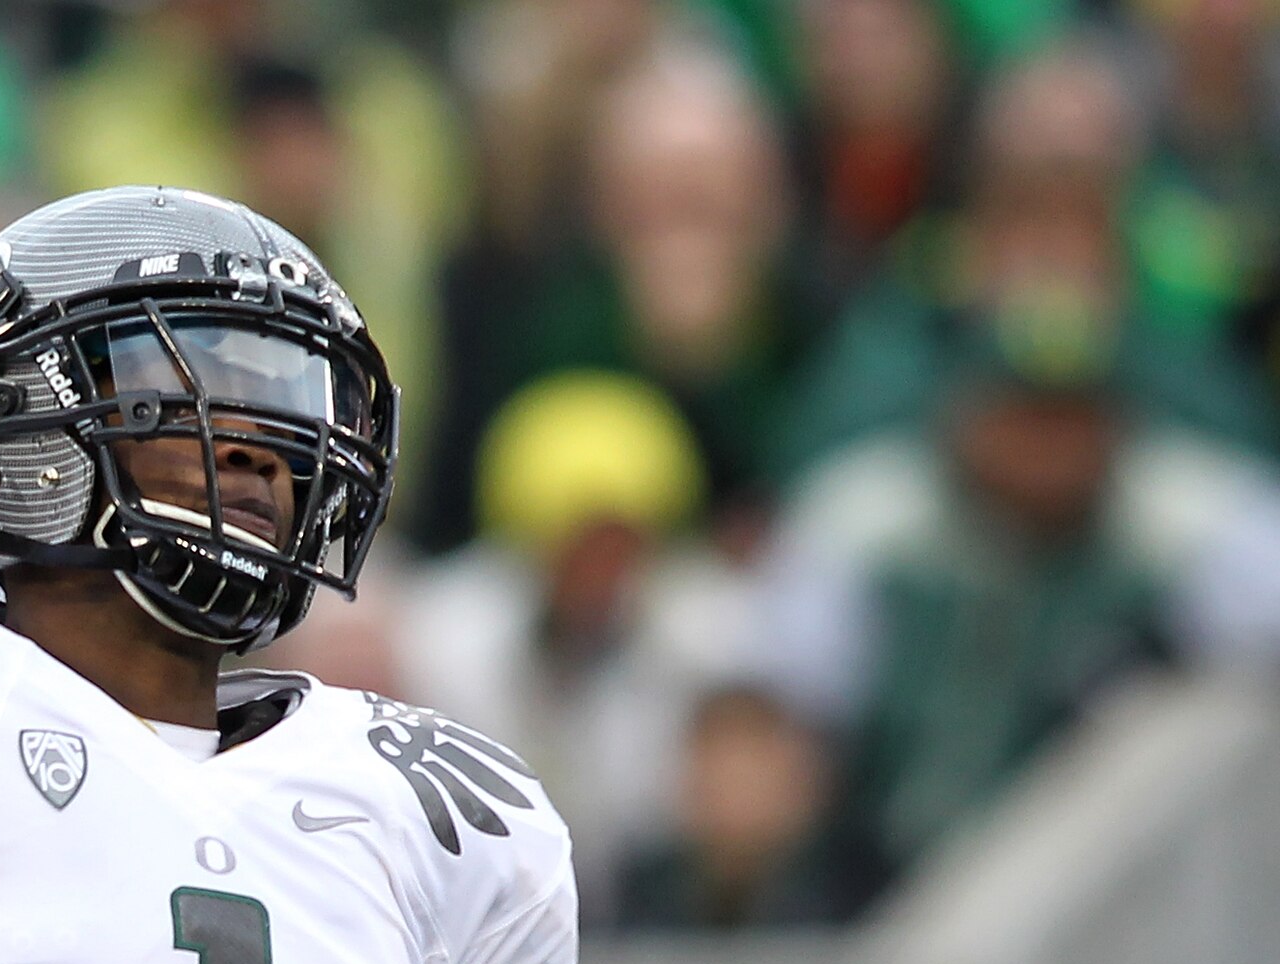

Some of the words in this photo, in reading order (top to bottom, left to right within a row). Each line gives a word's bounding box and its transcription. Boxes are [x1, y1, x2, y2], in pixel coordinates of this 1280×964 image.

[138, 253, 180, 278] NIKE
[35, 347, 96, 436] Riddll
[221, 550, 268, 581] Riddell
[21, 732, 84, 780] PAC
[194, 836, 236, 875] O
